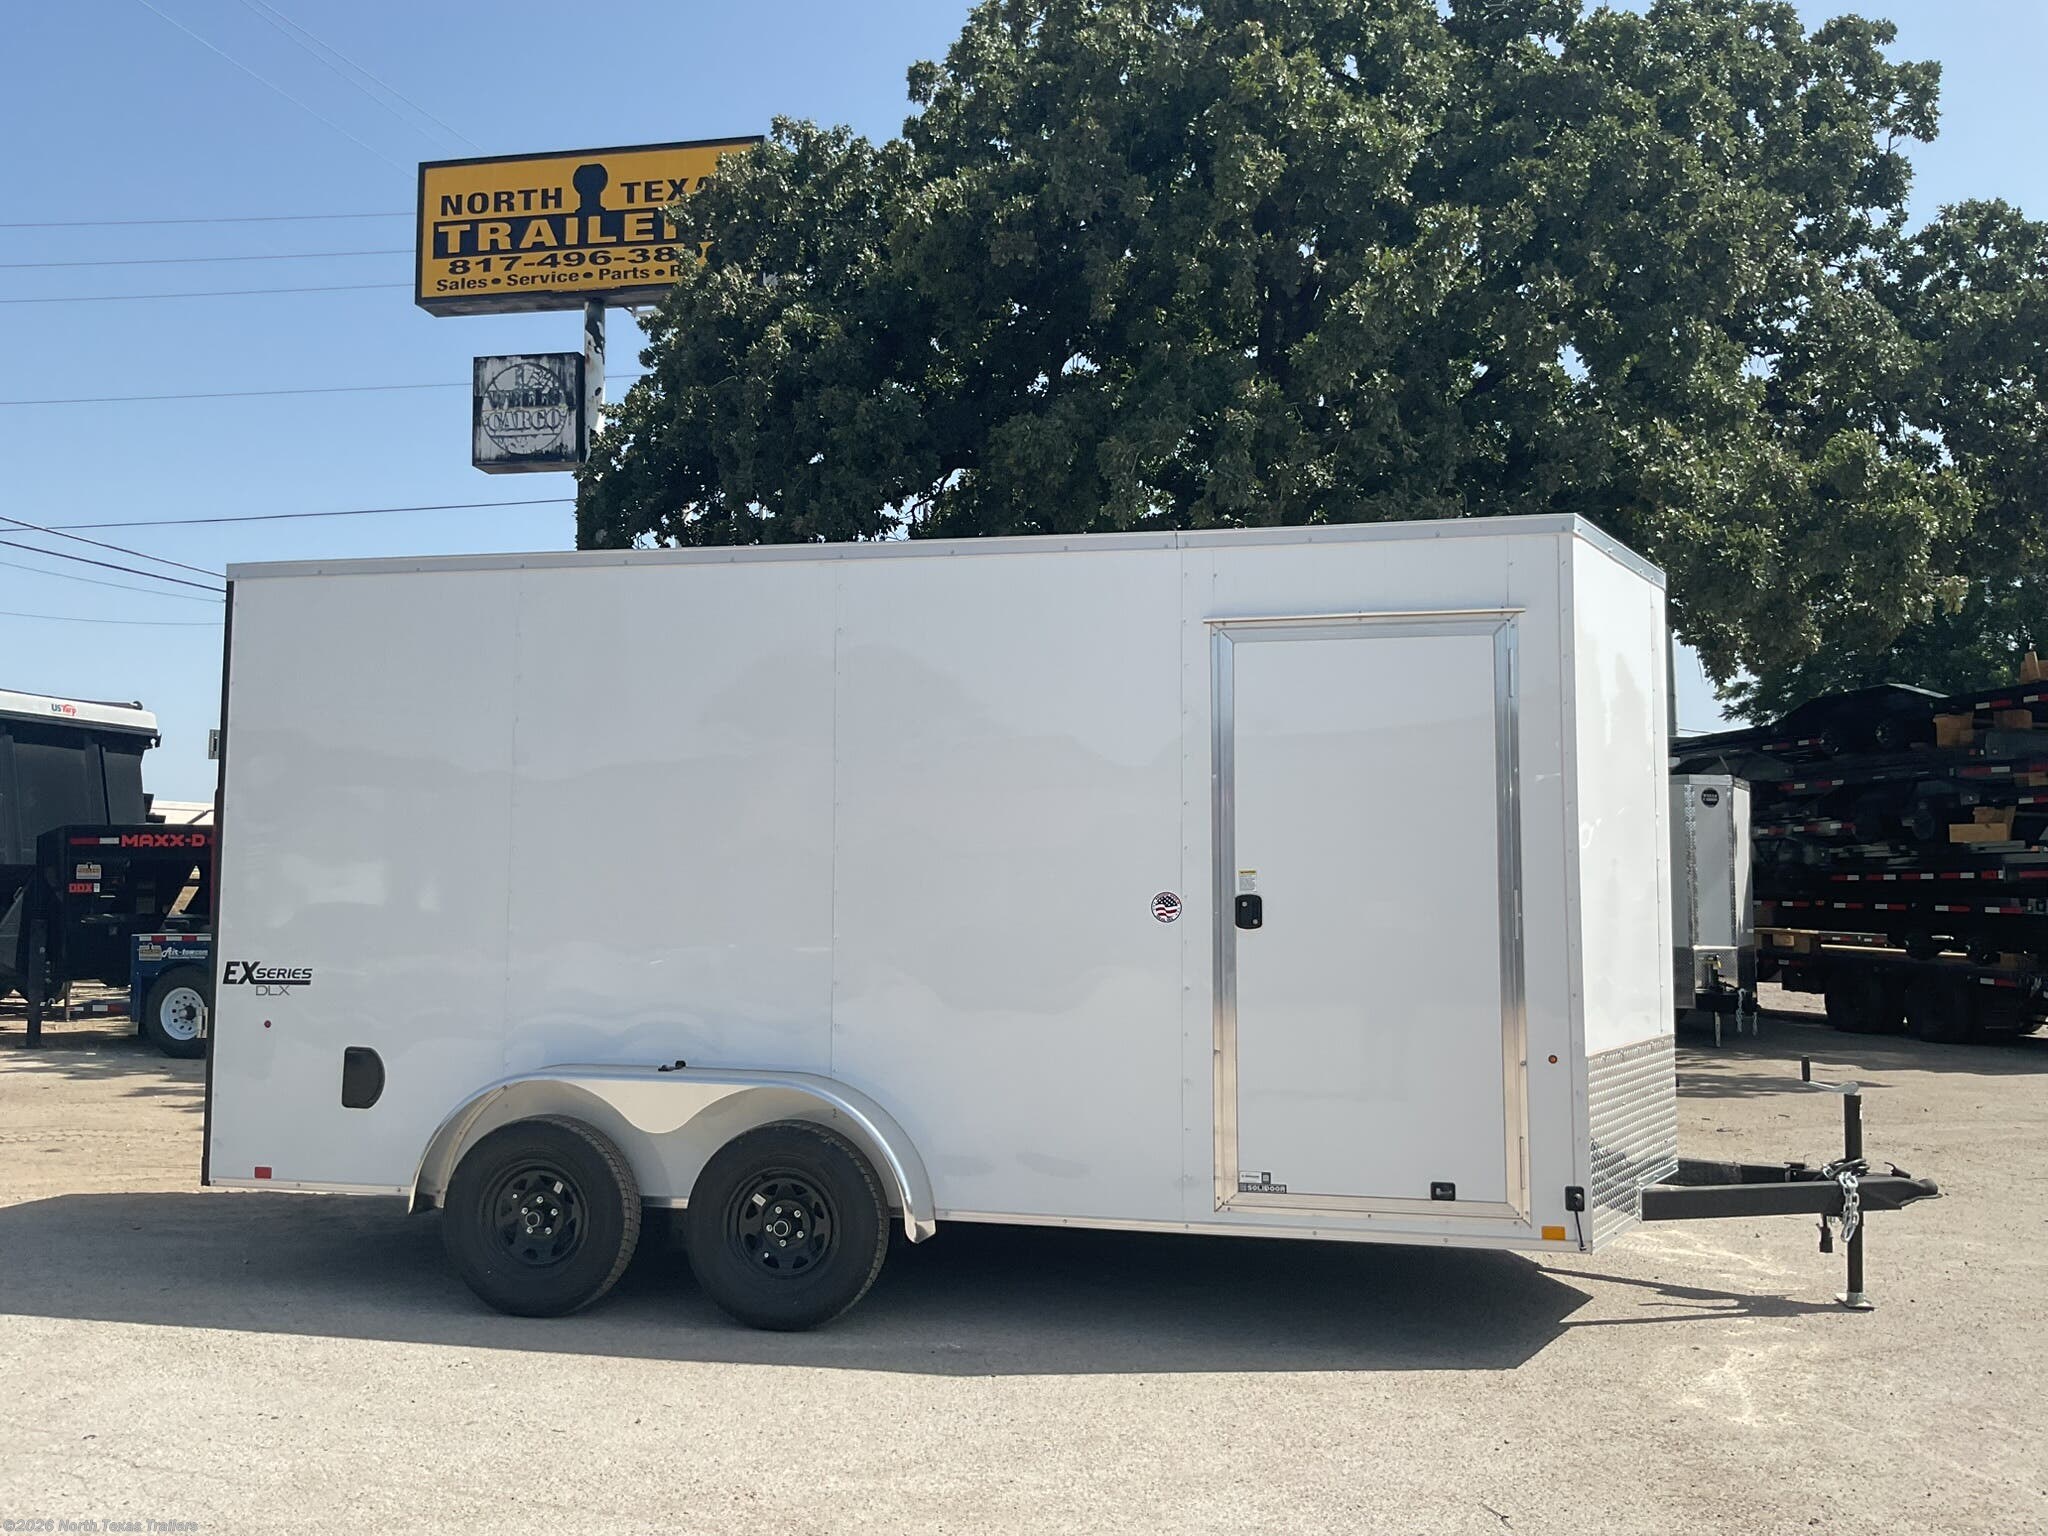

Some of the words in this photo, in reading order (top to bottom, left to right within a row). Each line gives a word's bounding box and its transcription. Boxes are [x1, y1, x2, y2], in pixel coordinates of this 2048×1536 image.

[440, 187, 563, 217] NORTH
[436, 278, 488, 292] Sales
[506, 270, 580, 287] Service
[599, 267, 650, 281] Parts
[487, 409, 561, 432] CARGO
[121, 833, 206, 848] MAXX-D
[255, 985, 290, 996] DLX
